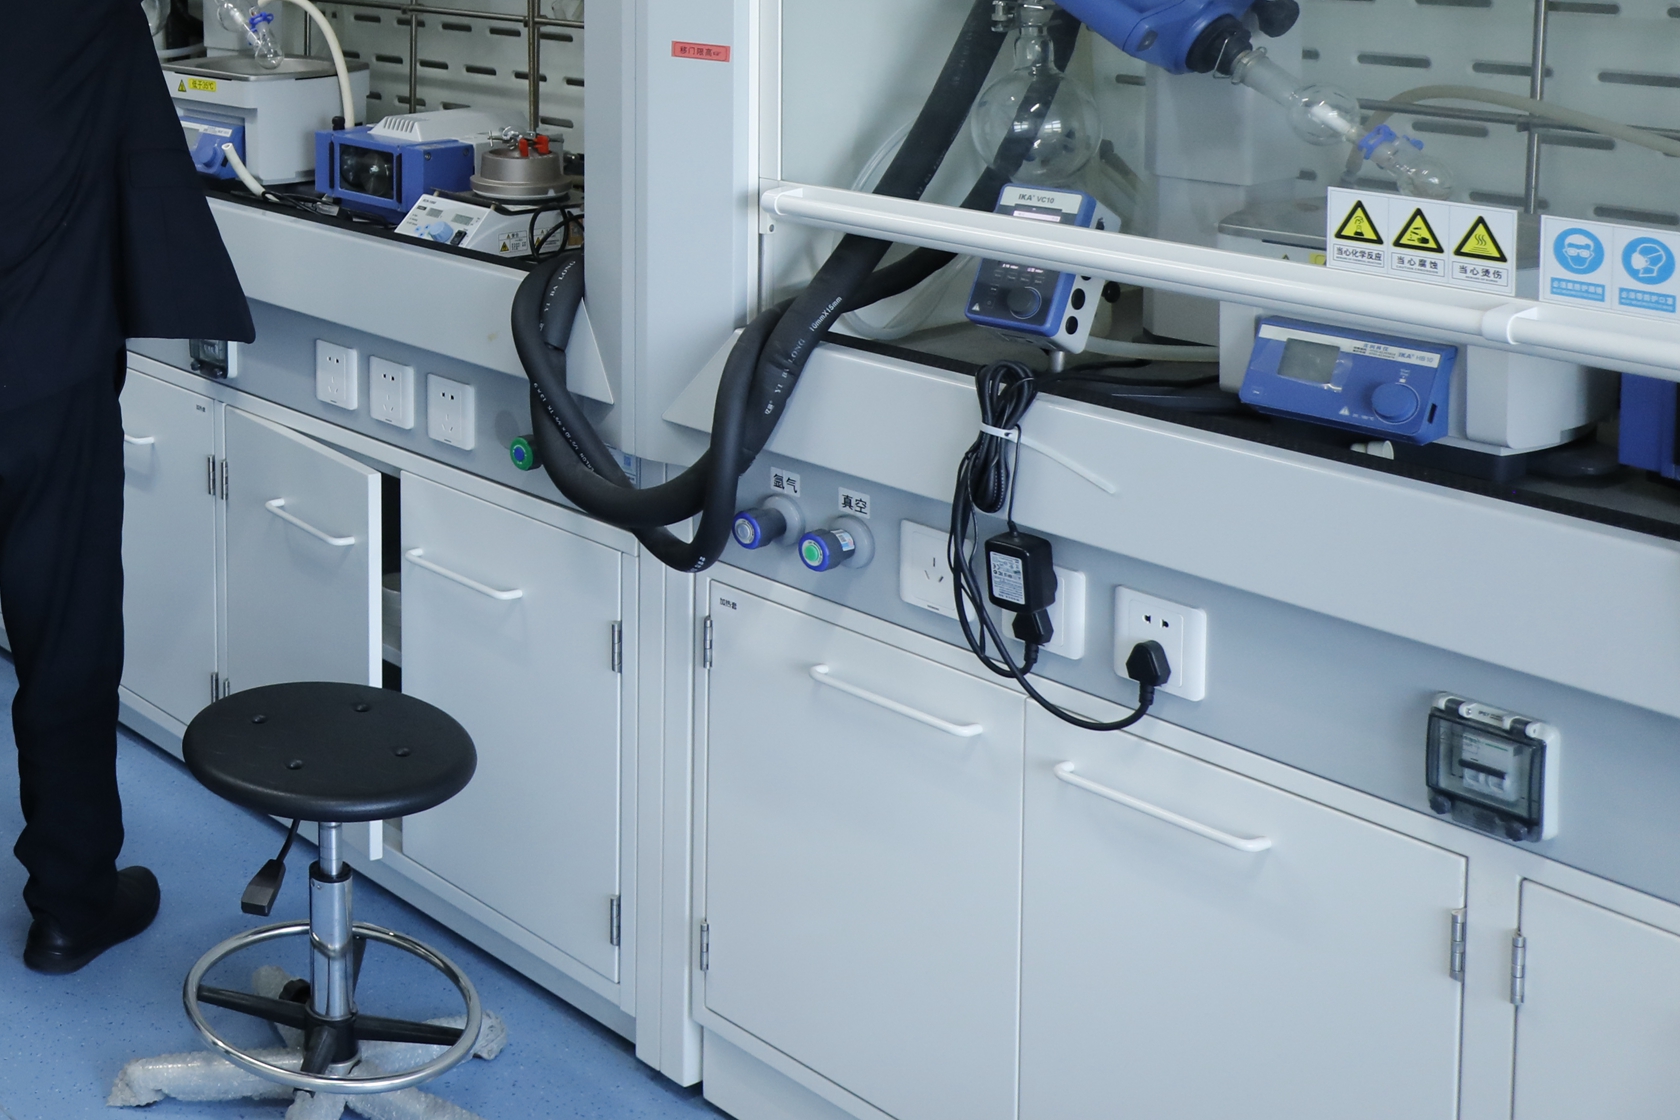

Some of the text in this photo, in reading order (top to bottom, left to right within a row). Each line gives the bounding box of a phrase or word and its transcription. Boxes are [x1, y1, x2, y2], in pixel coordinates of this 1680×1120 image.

[1018, 193, 1033, 202] IKA
[1336, 246, 1383, 262] 当心化学反应
[1396, 255, 1439, 270] 当心腐蚀
[1458, 264, 1503, 280] 当心烫伤
[773, 473, 798, 494] 氩气
[841, 493, 868, 515] 真空
